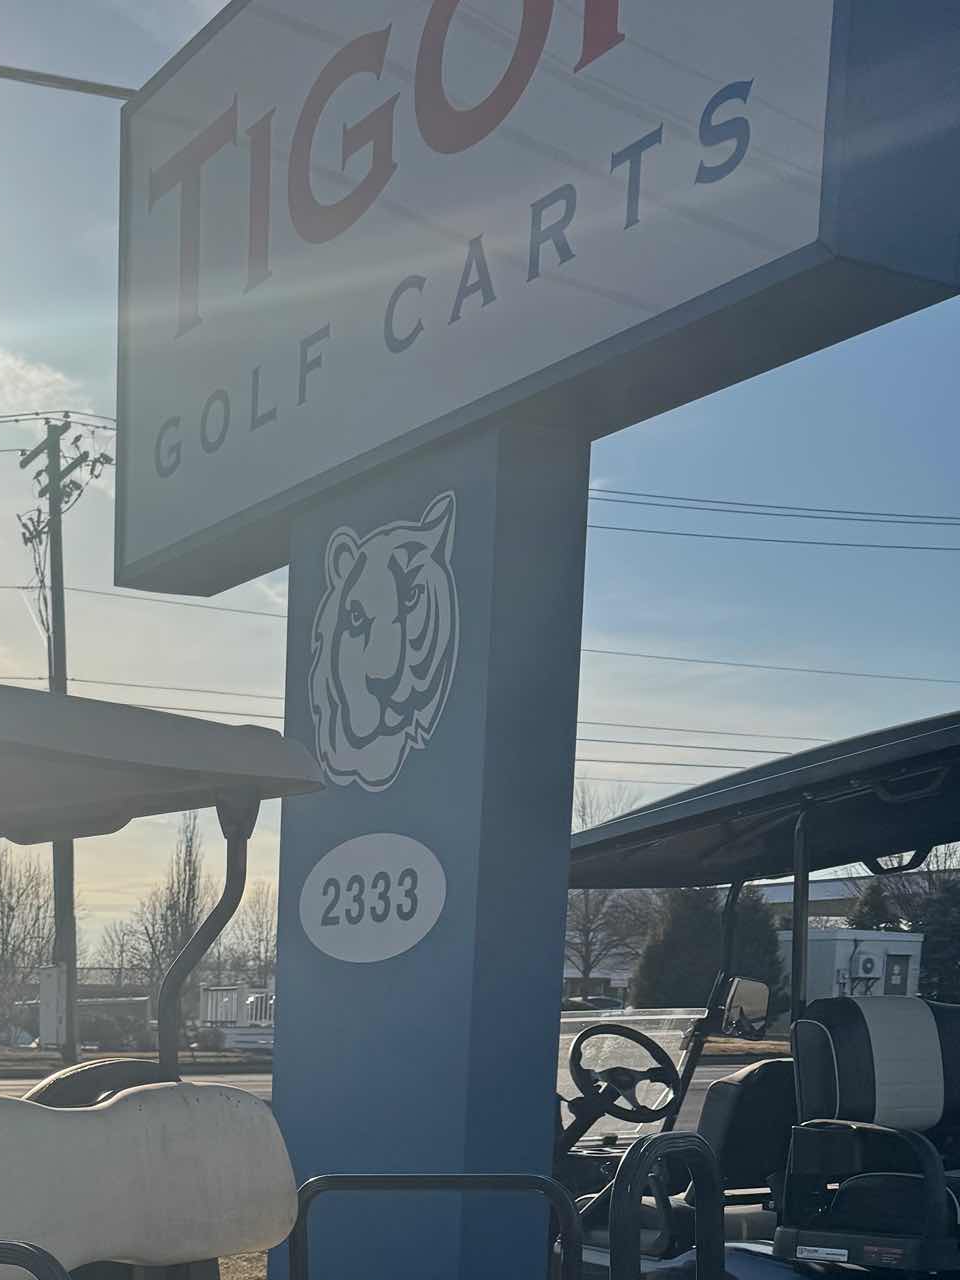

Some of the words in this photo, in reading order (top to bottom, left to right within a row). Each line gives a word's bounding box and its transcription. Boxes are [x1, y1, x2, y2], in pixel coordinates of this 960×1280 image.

[154, 321, 332, 479] GOLF
[383, 78, 754, 353] CARTS
[320, 867, 419, 927] 2333
